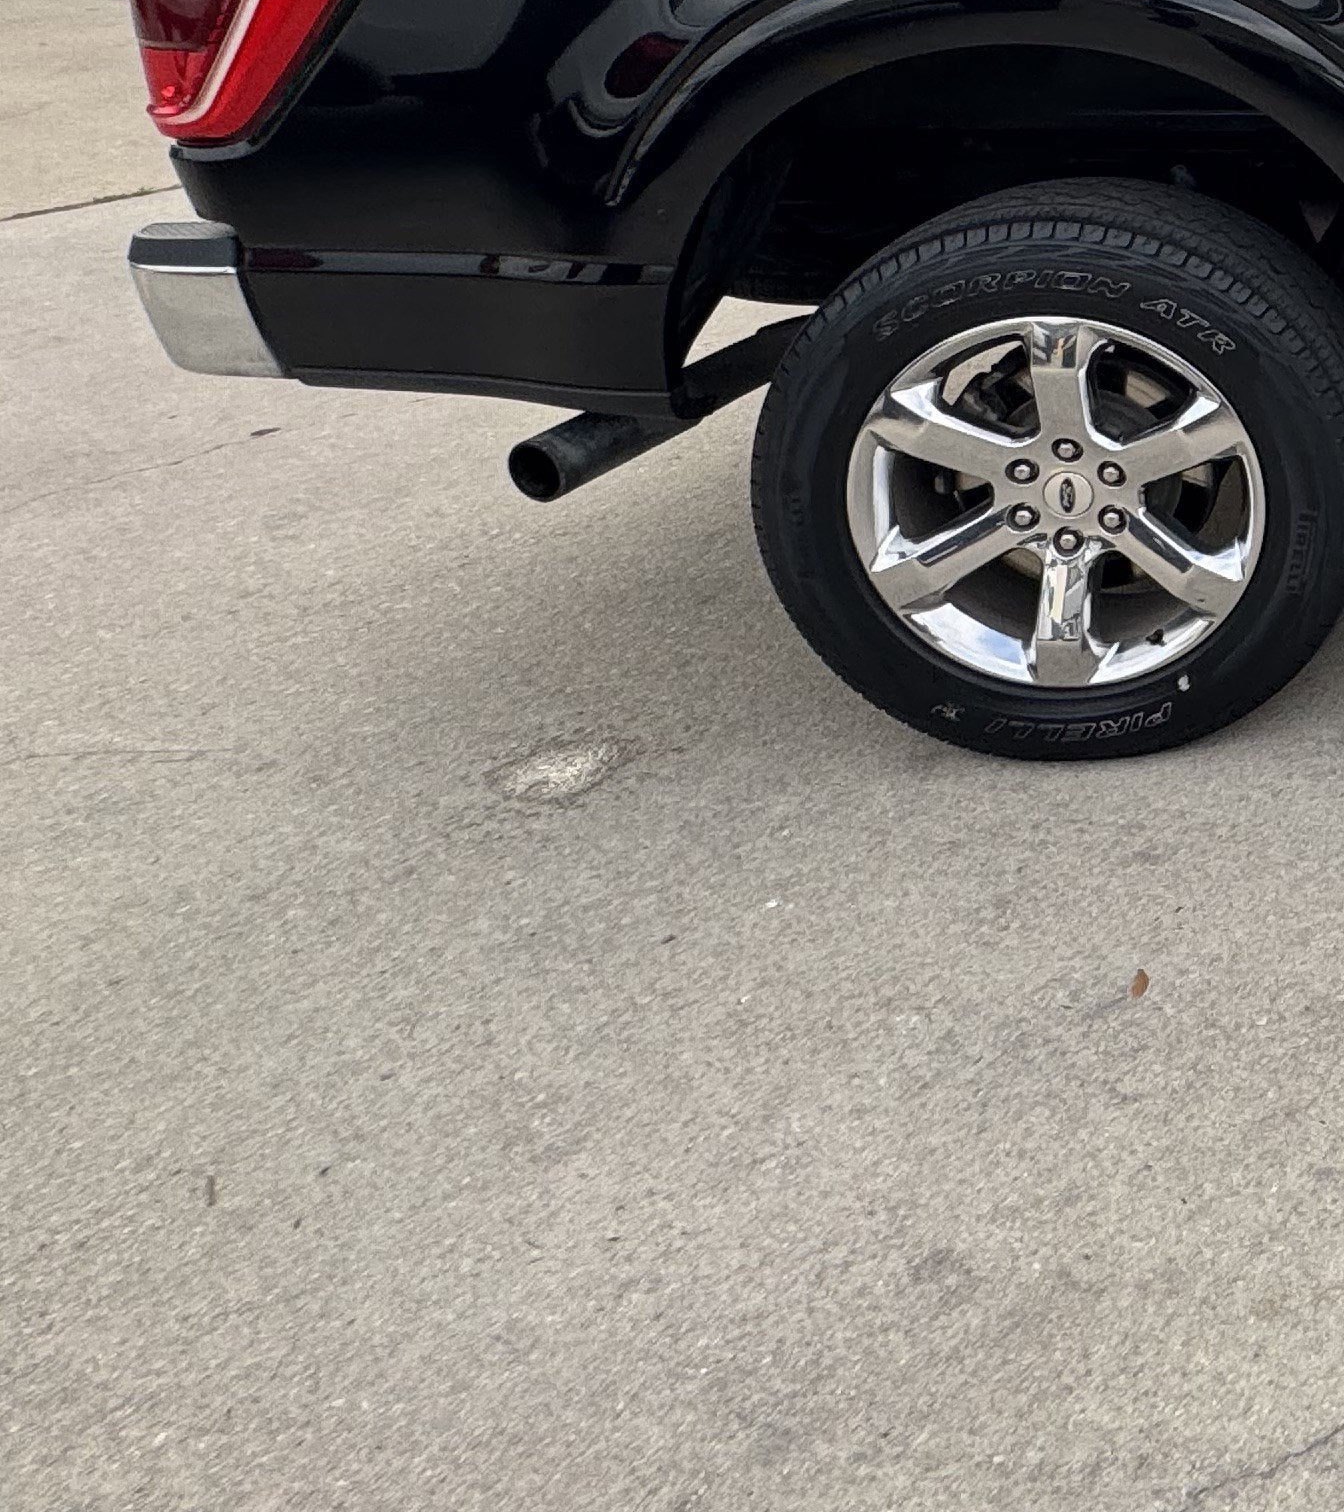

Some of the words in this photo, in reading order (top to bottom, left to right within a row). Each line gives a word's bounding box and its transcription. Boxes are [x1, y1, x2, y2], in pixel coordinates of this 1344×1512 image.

[873, 265, 1131, 339] SCORPION
[1139, 299, 1236, 355] ATR
[983, 701, 1173, 742] PIRELLI
